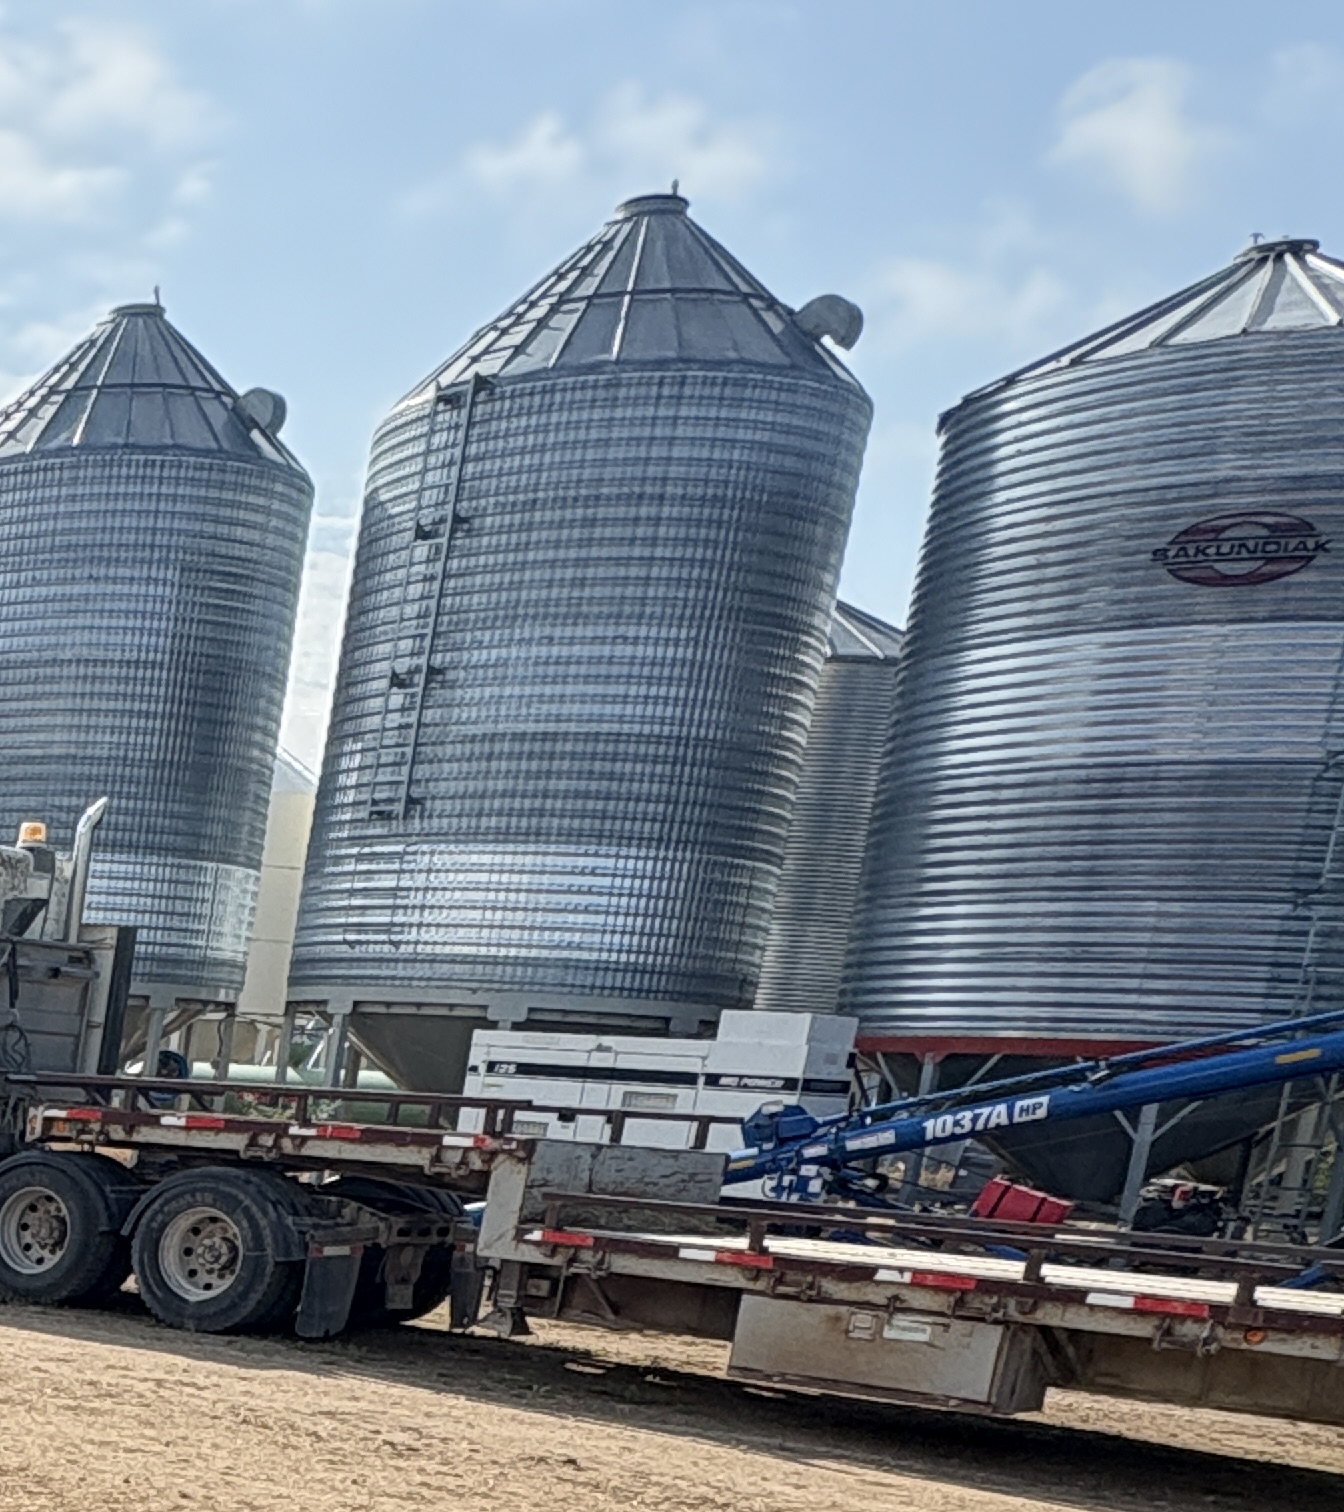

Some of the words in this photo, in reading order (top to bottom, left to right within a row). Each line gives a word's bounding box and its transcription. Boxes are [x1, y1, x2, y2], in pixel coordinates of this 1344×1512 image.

[1151, 538, 1334, 562] SAKUNDIAK
[922, 1103, 1010, 1142] 1037A
[1017, 1101, 1044, 1118] HP
